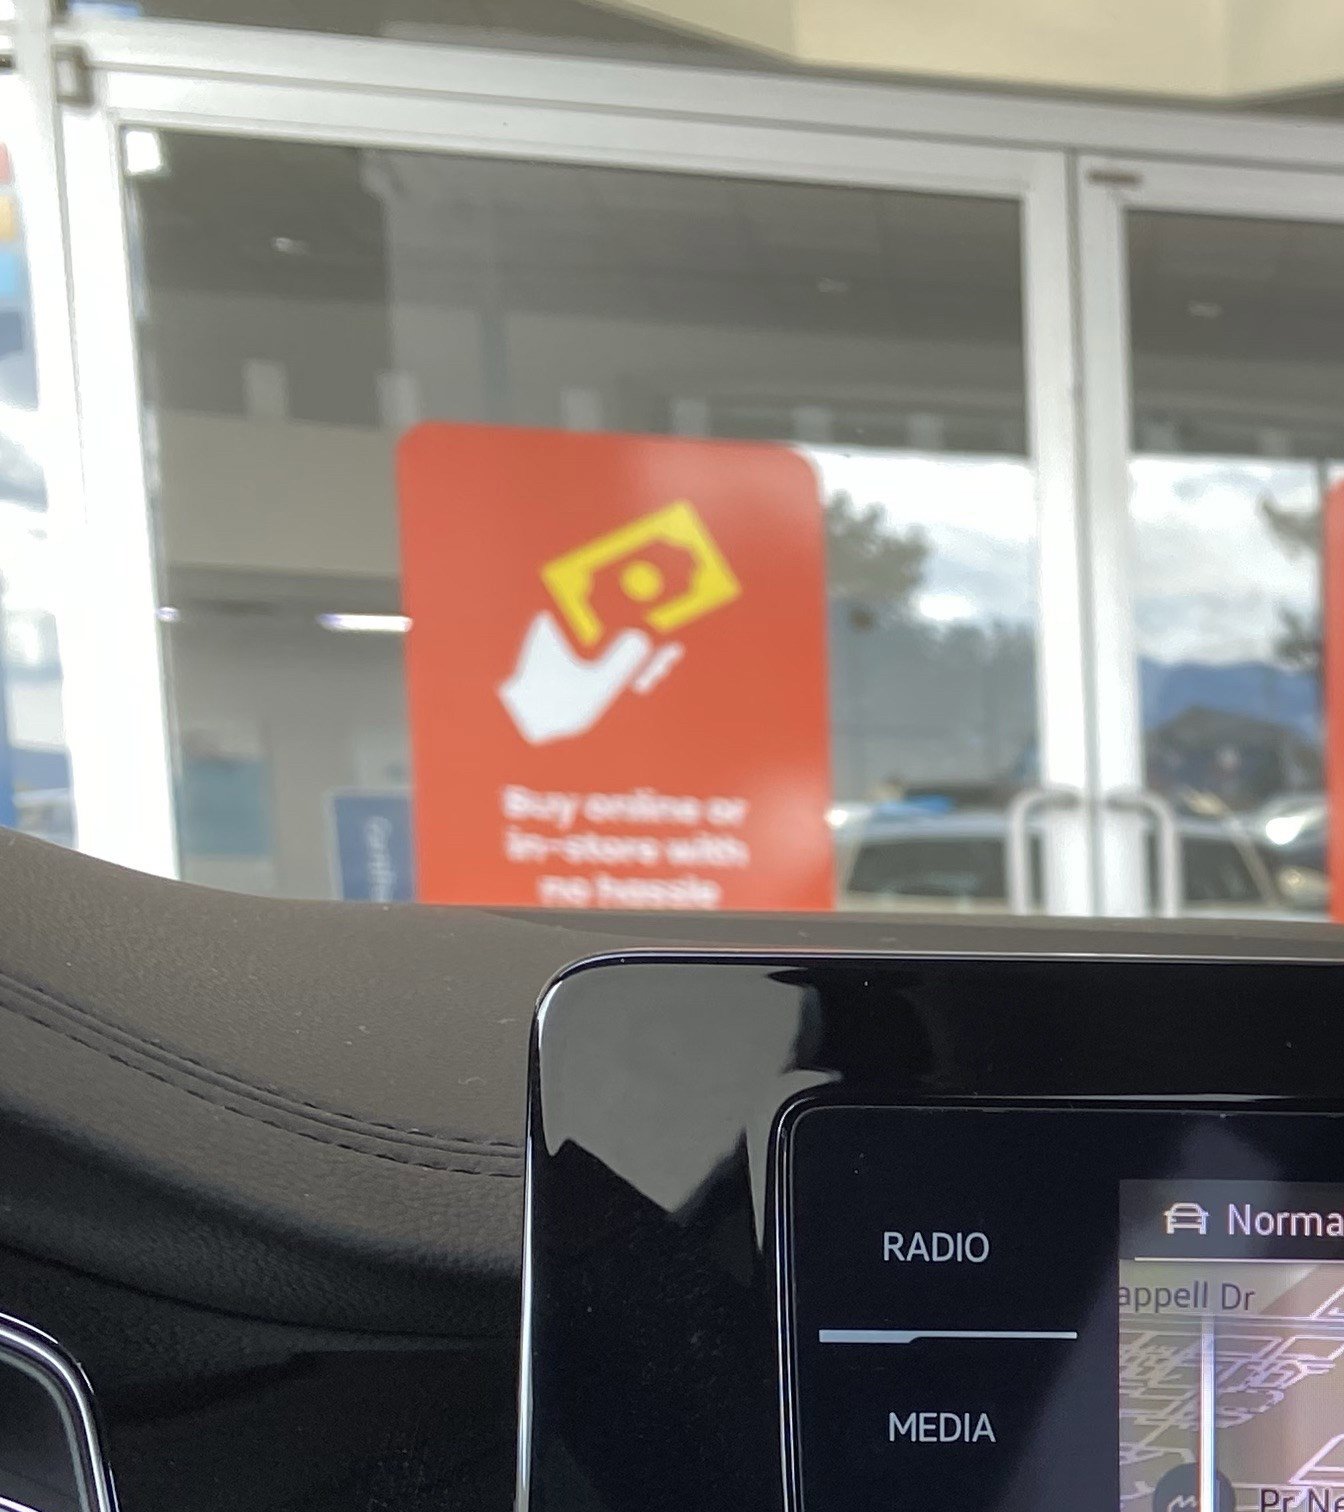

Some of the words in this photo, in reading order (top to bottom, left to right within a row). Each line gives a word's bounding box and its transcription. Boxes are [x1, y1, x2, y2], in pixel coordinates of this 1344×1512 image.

[502, 785, 576, 829] Buy
[584, 787, 701, 825] online
[706, 796, 747, 825] or
[505, 826, 659, 865] in-store
[665, 831, 751, 867] with
[536, 874, 591, 908] no
[884, 1231, 990, 1263] RADIO
[1222, 1282, 1256, 1311] Dr
[889, 1411, 996, 1443] MEDIA
